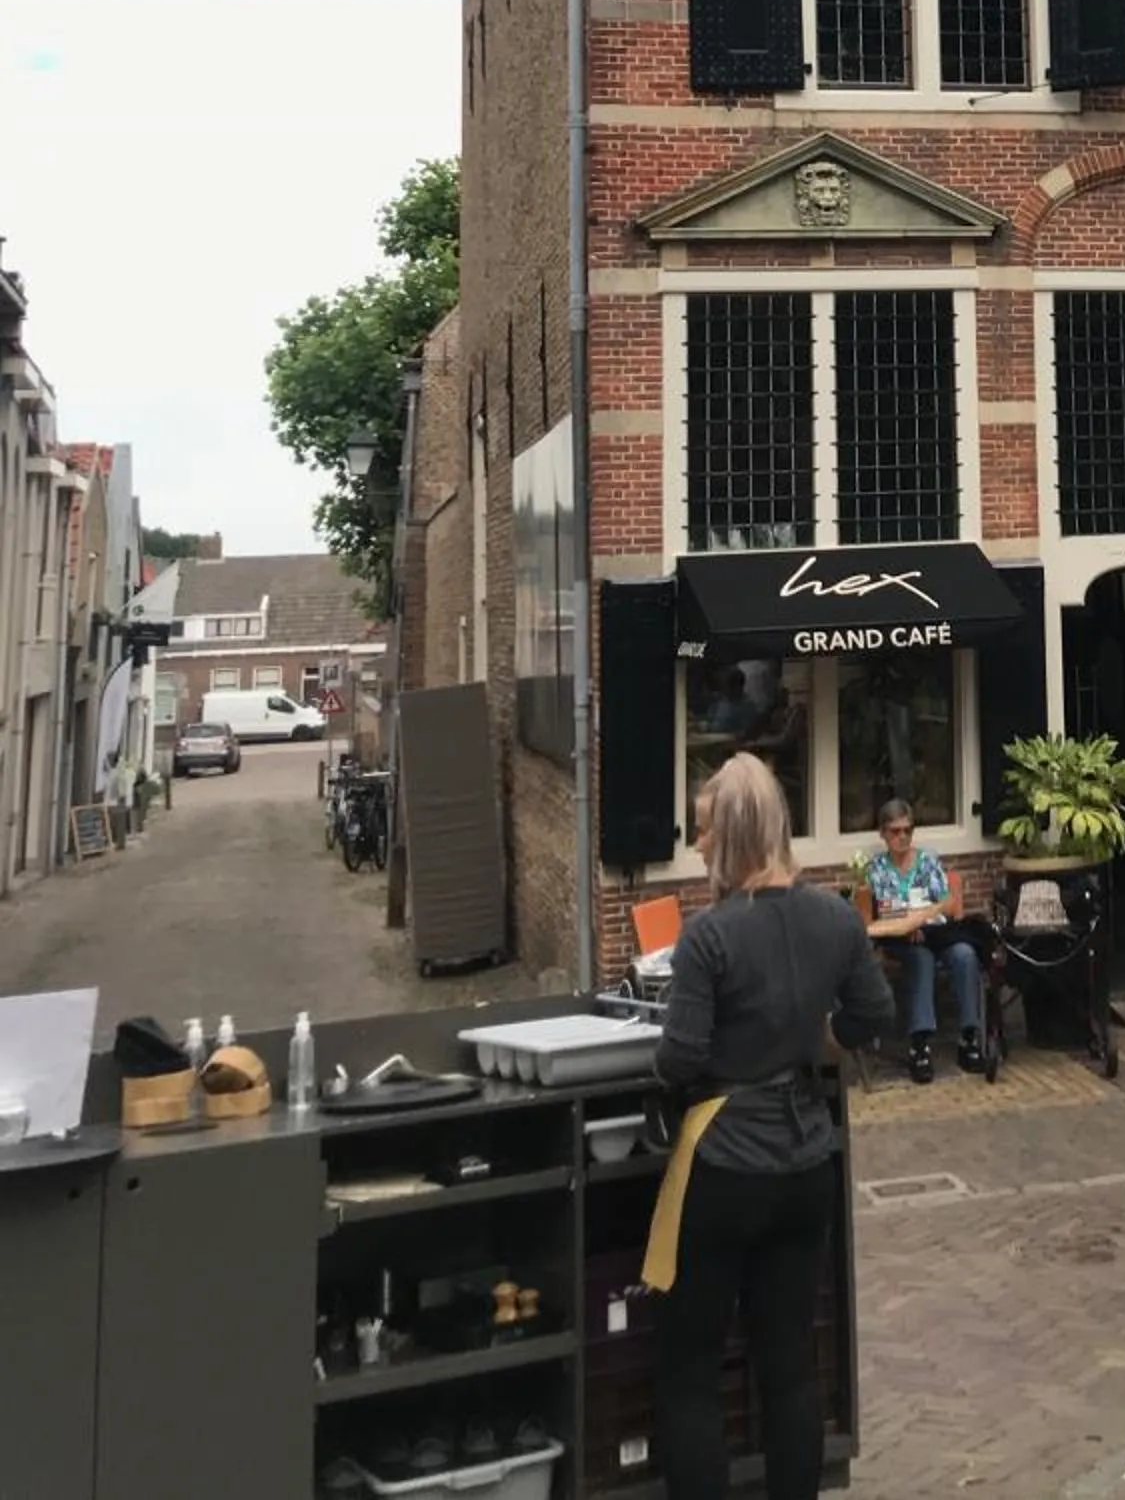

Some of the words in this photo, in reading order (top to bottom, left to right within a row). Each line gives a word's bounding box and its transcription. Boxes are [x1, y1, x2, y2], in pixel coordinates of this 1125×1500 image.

[780, 556, 939, 608] hex
[794, 628, 883, 652] GRAND
[890, 621, 952, 647] CAFÉ
